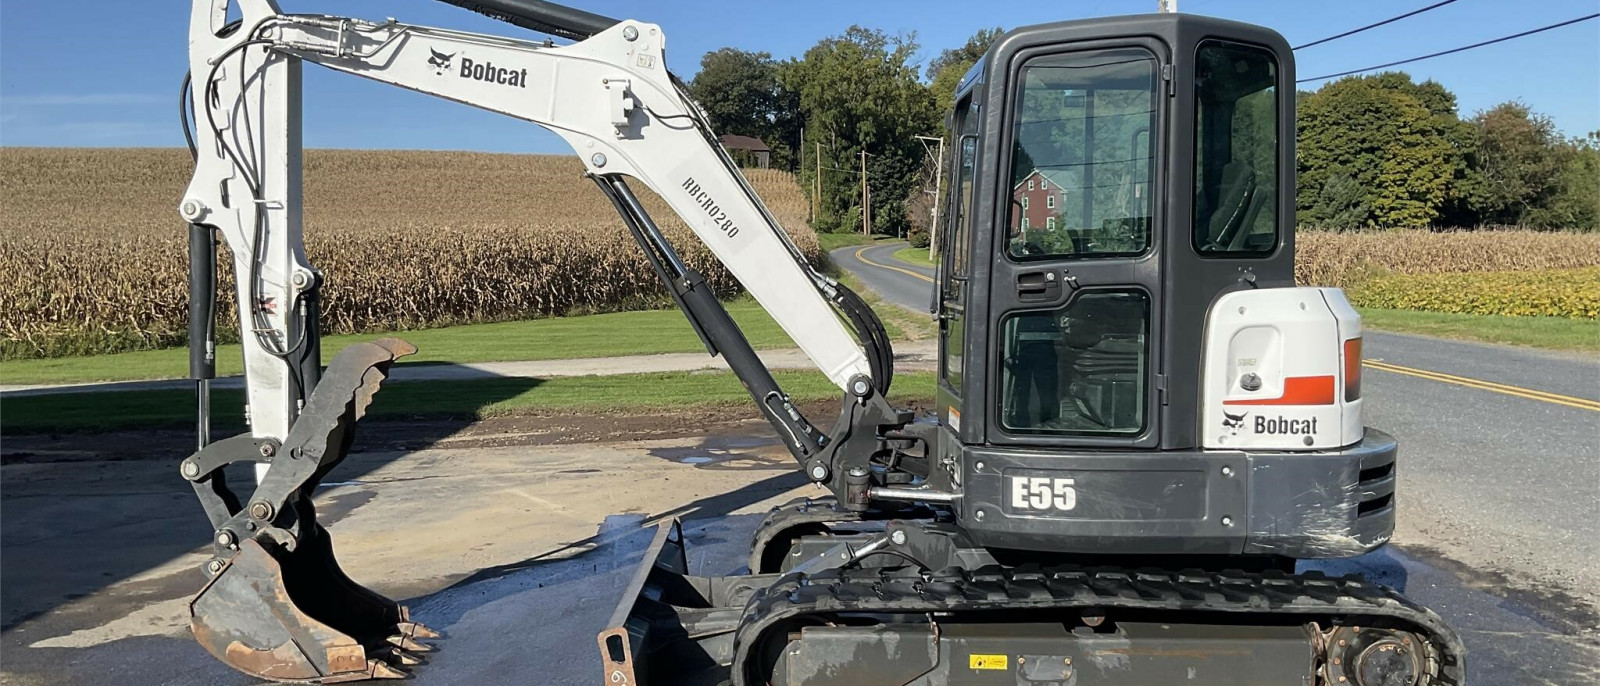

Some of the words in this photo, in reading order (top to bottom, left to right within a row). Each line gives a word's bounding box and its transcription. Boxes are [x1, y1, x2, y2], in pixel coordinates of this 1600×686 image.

[460, 57, 527, 88] Bobcat
[681, 176, 740, 239] RBCR0280
[1254, 415, 1317, 435] Bobcat
[1012, 477, 1076, 511] E55
